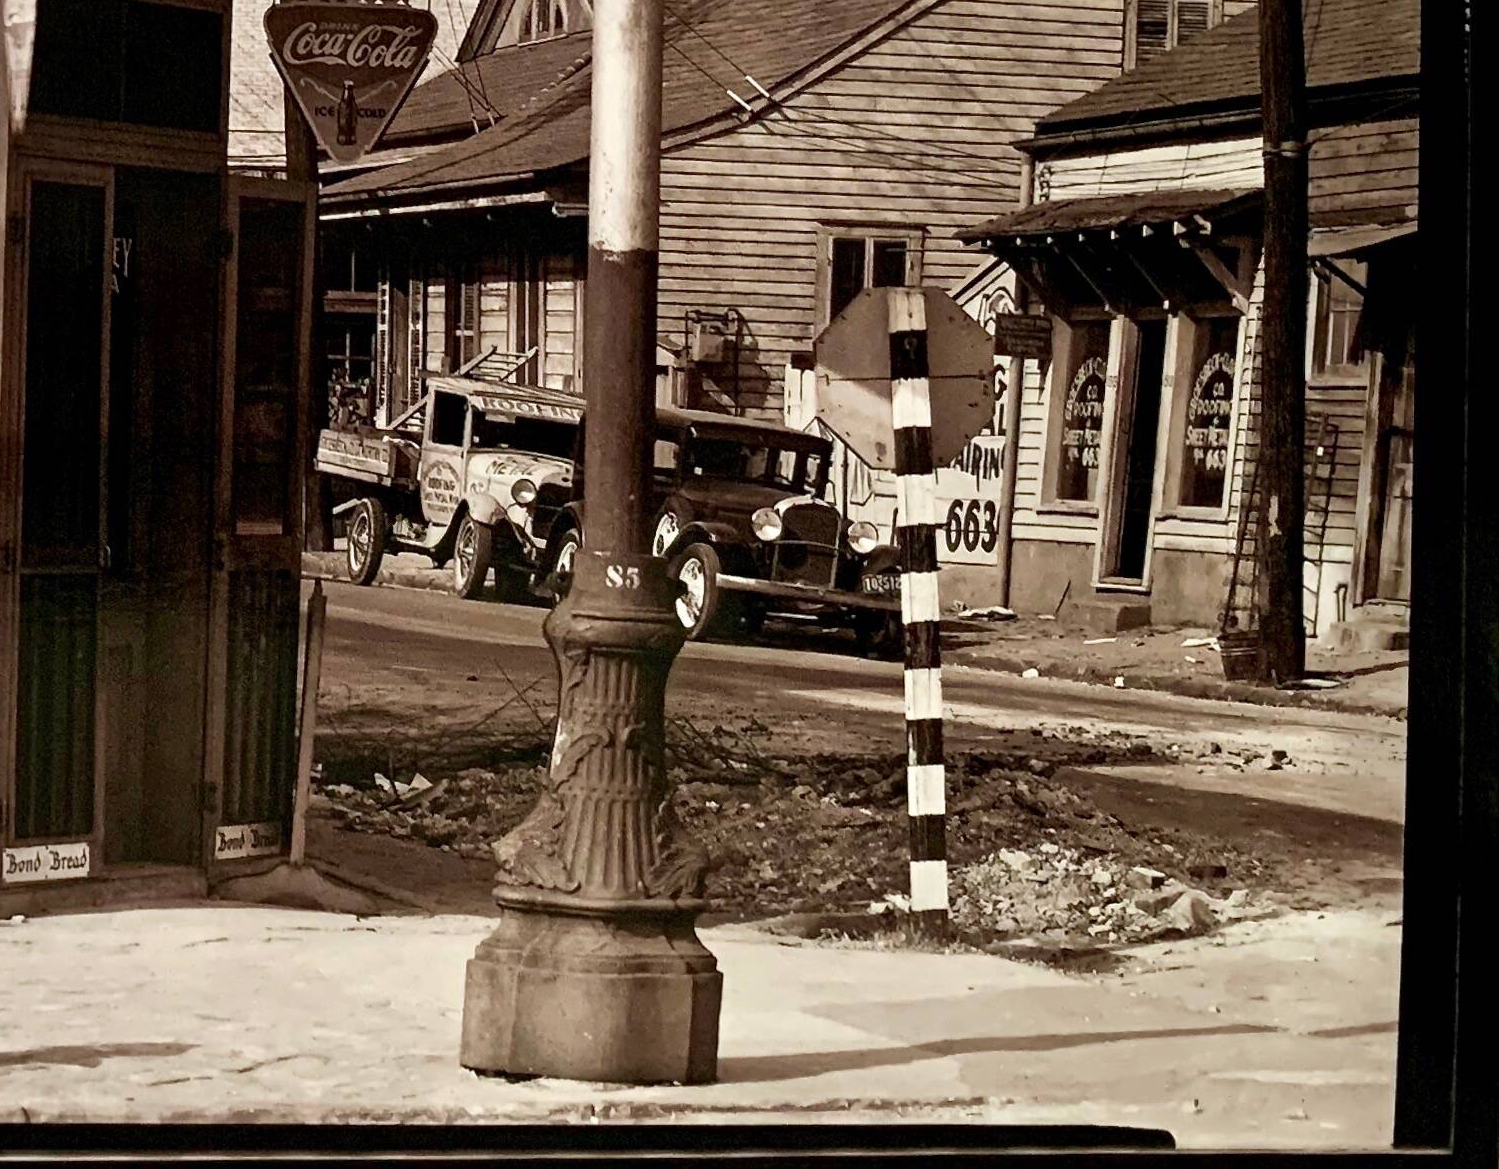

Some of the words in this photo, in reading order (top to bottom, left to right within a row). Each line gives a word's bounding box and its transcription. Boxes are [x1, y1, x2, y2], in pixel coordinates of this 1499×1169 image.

[283, 22, 424, 69] Coca-Cola
[315, 106, 336, 117] ICE
[356, 107, 386, 119] COLD
[945, 498, 997, 553] 663
[605, 564, 640, 589] 85
[5, 851, 42, 874] Bond
[49, 849, 88, 871] Bread
